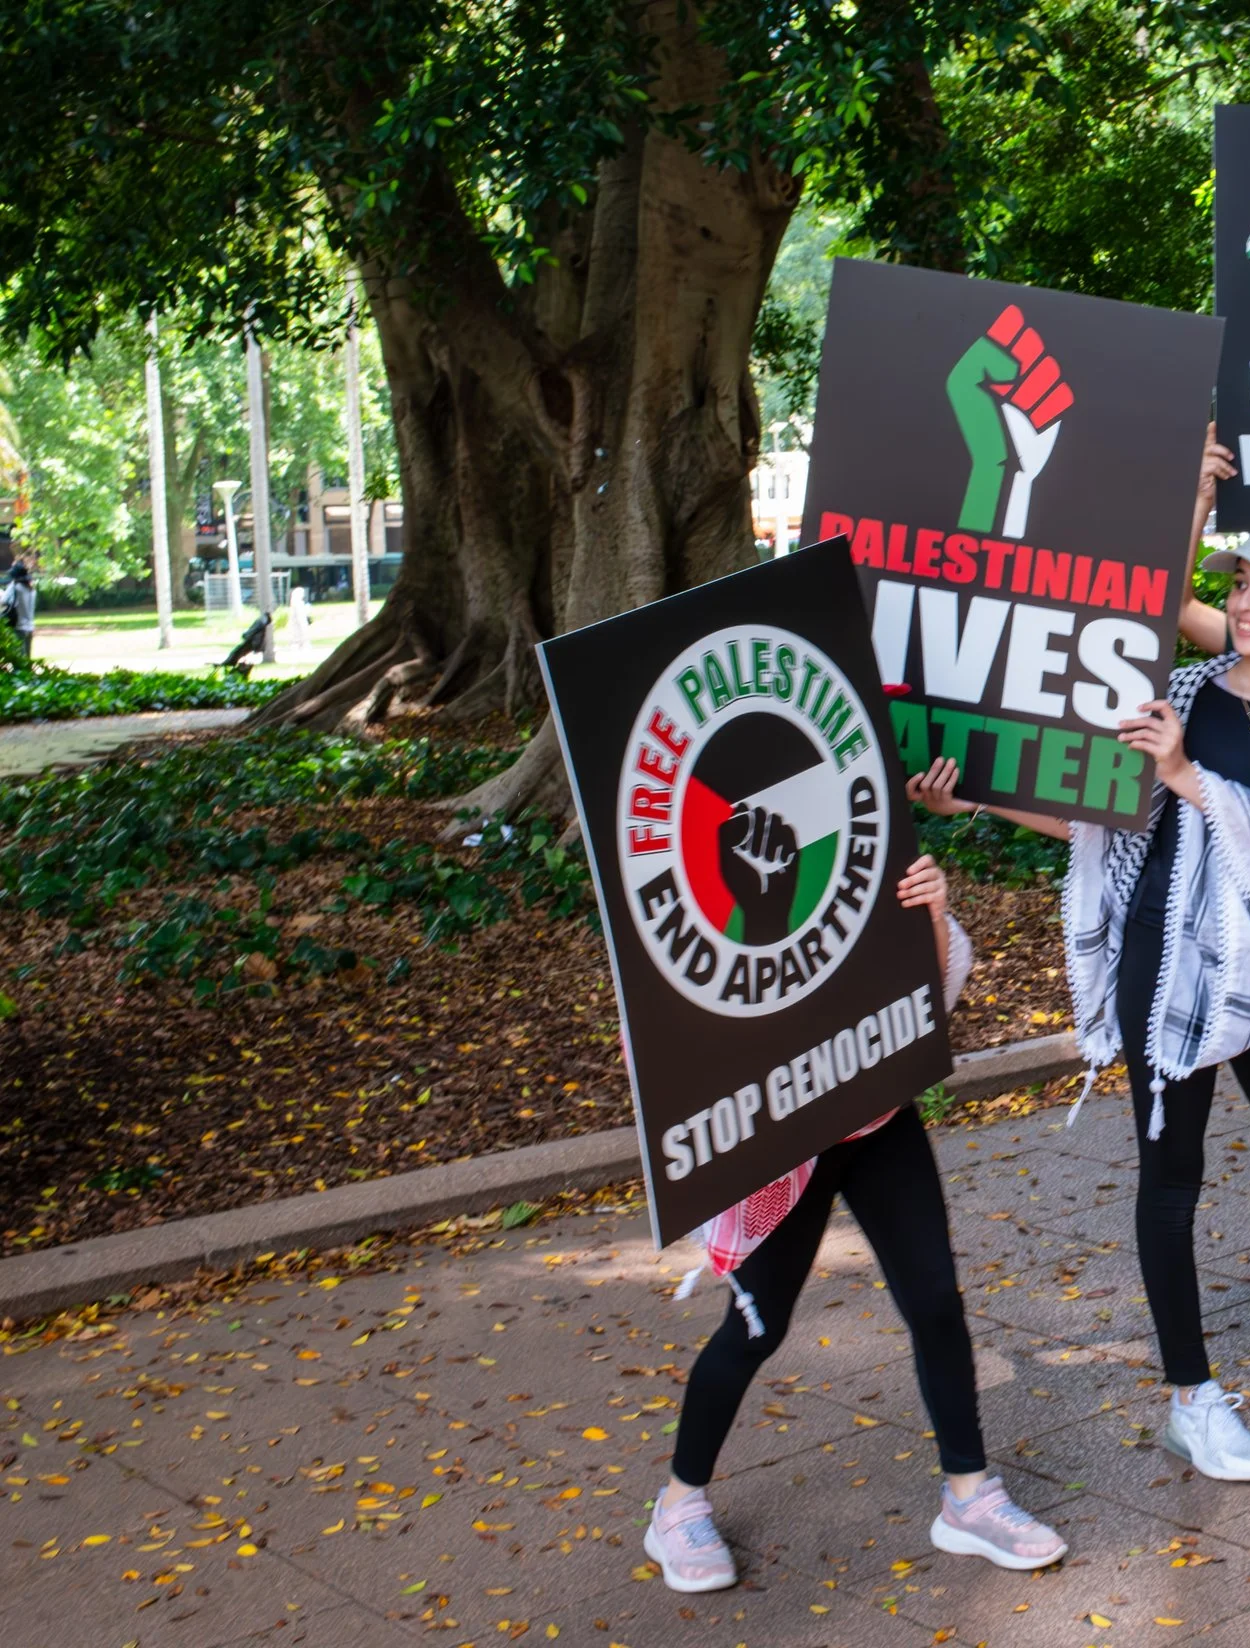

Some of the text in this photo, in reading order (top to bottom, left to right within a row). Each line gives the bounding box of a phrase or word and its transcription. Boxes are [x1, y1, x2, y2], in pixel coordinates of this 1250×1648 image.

[628, 637, 870, 858] FREE PALESTINE
[871, 579, 1160, 730] IVES
[888, 700, 1145, 816] ATTER
[637, 775, 880, 1005] END APARTHEID
[661, 984, 937, 1183] STOP GENOCIDE
